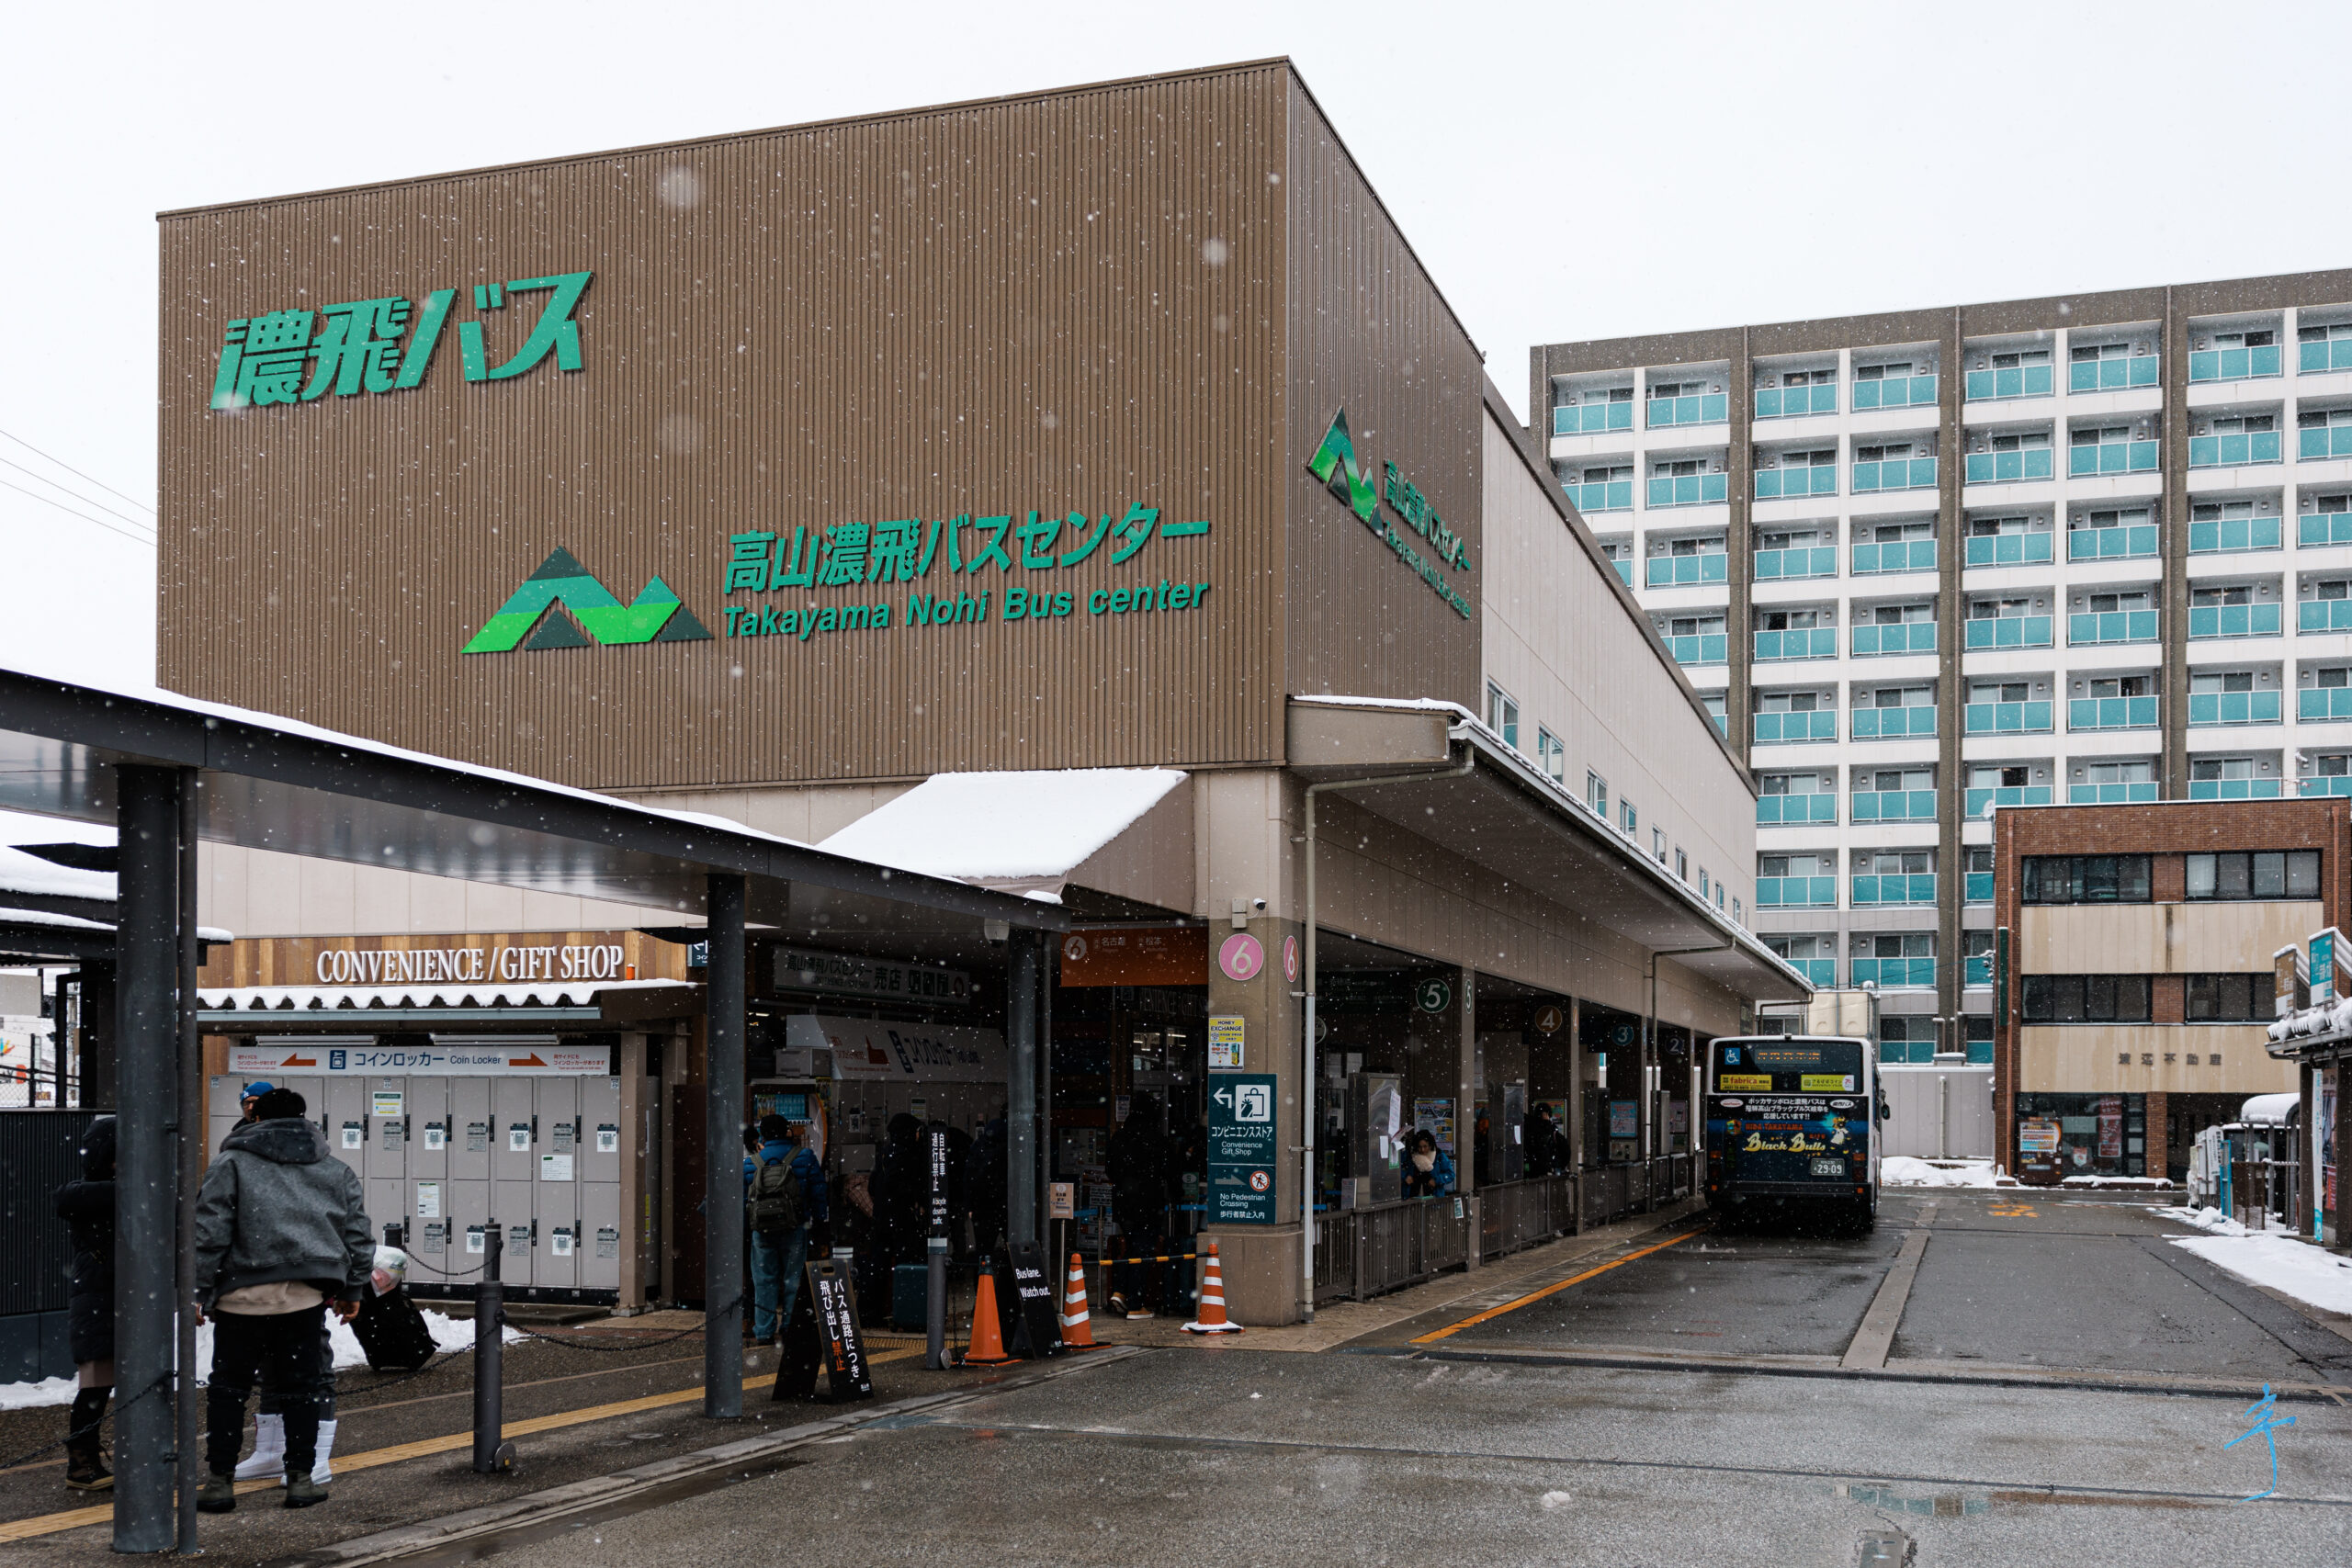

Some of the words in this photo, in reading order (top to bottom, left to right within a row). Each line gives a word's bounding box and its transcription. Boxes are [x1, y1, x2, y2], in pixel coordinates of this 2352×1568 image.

[209, 271, 593, 410] 濃飛バス
[723, 502, 1209, 593] 高山濃飛バスセンター
[723, 603, 889, 641] Takayama
[906, 590, 989, 626] Nohi
[1003, 587, 1073, 620] Bus
[1088, 580, 1209, 615] center
[1070, 939, 1080, 956] 6
[1231, 941, 1252, 974] 6
[316, 948, 485, 983] CONVENIENCE
[560, 944, 625, 979] SHOP
[1288, 943, 1295, 976] 6
[874, 966, 902, 991] 売店
[1424, 984, 1441, 1009] 5
[1541, 1009, 1555, 1029] 4
[1618, 1026, 1629, 1043] 3
[1669, 1038, 1680, 1053] 2
[355, 1052, 445, 1066] コインロッカー
[450, 1055, 469, 1065] Coin
[472, 1055, 502, 1065] Locker
[1211, 1126, 1273, 1138] コンビニエンスストア
[1744, 1132, 1788, 1152] Black
[1788, 1132, 1826, 1152] Bulls
[1235, 1148, 1252, 1156] Shop
[1220, 1200, 1249, 1209] Crossing
[1220, 1210, 1265, 1219] 歩行者禁止入内
[1015, 1268, 1026, 1279] Bus
[1026, 1268, 1041, 1278] lane.
[1020, 1286, 1039, 1298] Watch
[1039, 1286, 1051, 1296] out.
[820, 1280, 845, 1371] 飛び出し禁止
[834, 1278, 860, 1378] バス通路につき
